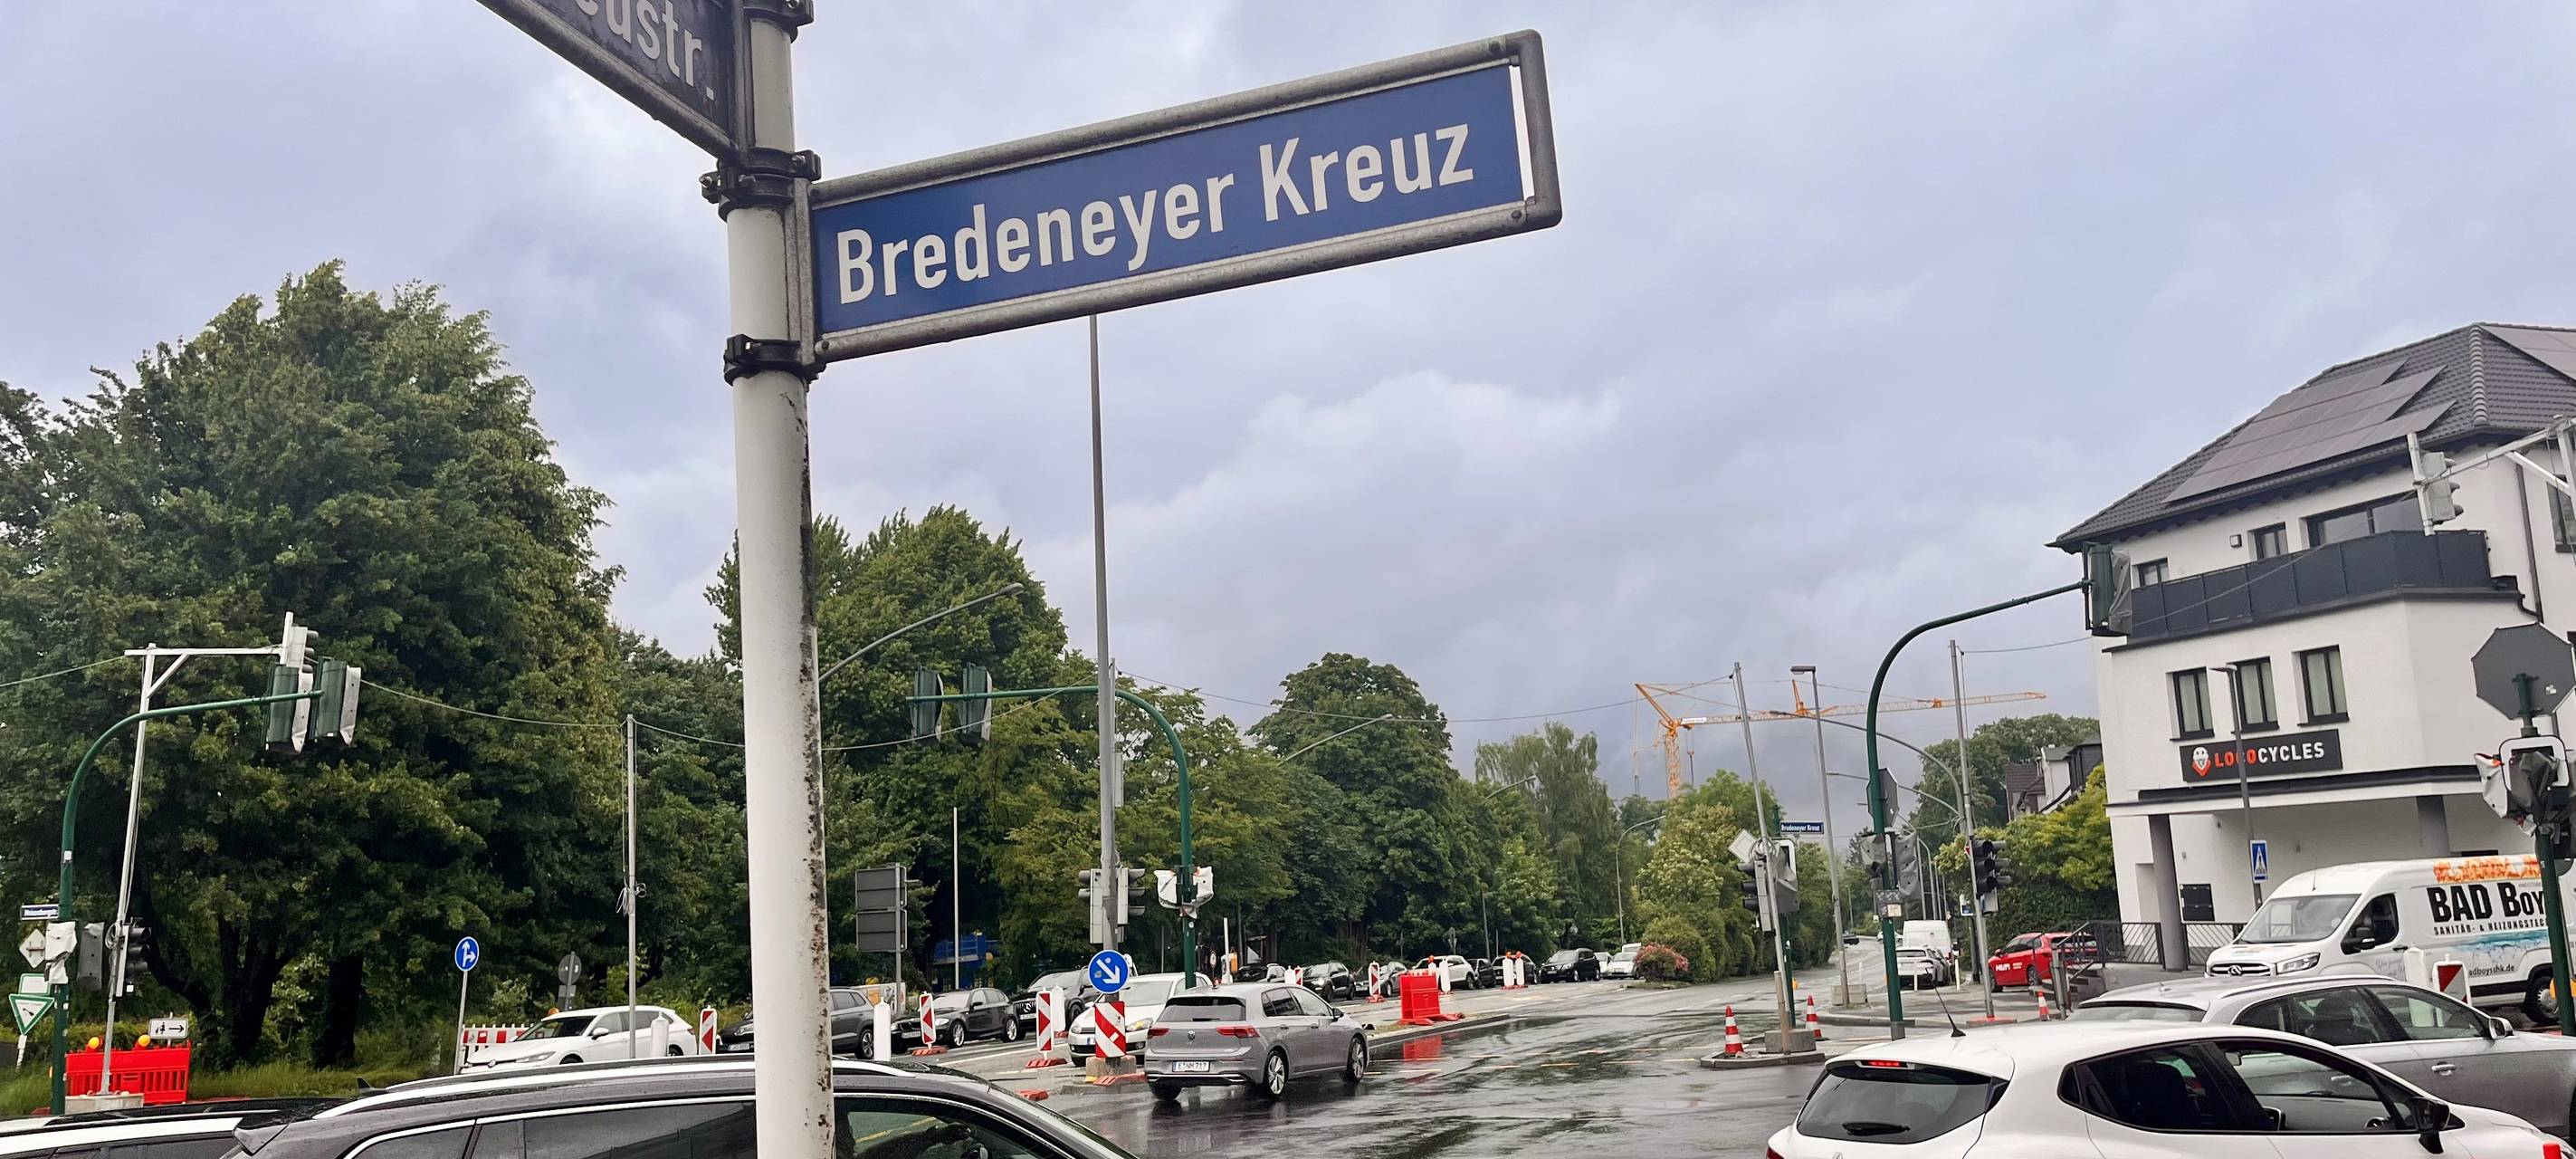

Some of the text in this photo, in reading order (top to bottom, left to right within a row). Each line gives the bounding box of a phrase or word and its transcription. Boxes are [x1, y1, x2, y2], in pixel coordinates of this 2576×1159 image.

[837, 123, 1474, 305] Bredeneyer Kreuz
[2427, 882, 2544, 922] BAD BOY
[2488, 918, 2548, 931] HEIZUNGSTEC
[2468, 963, 2515, 977] adboysshk.de
